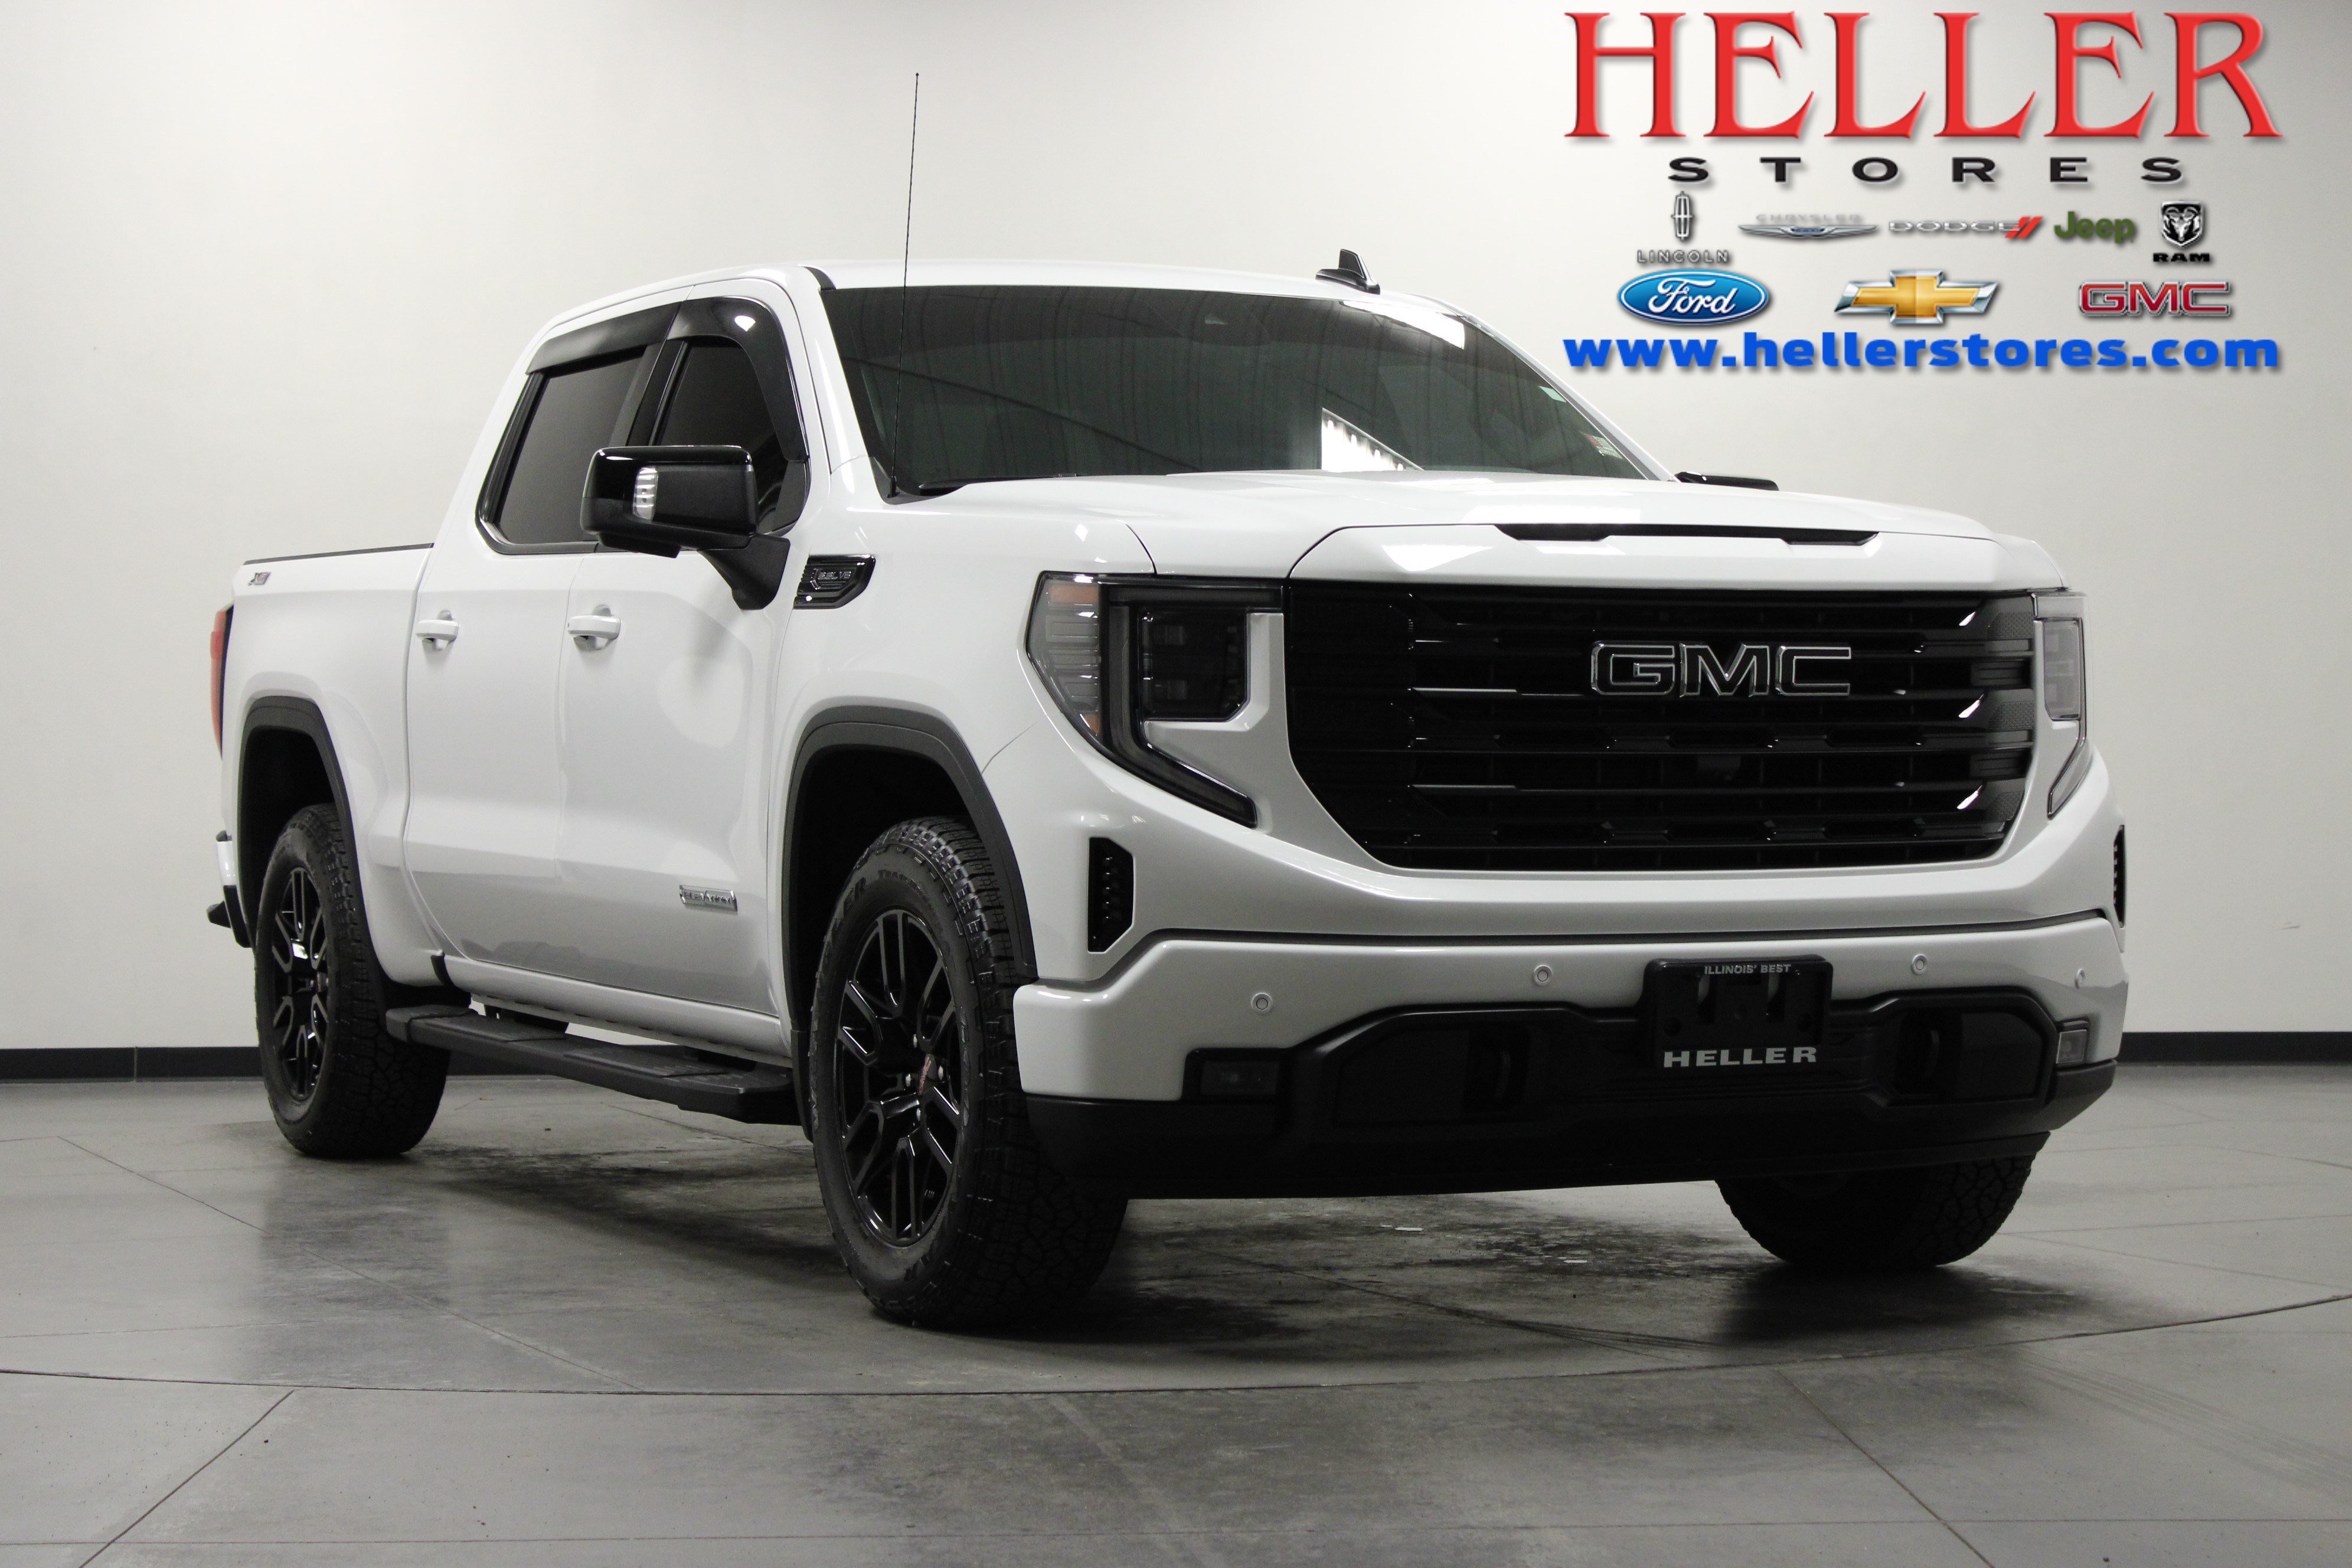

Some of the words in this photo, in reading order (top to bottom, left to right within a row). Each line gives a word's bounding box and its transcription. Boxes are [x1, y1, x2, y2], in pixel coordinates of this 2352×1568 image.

[1590, 641, 1851, 698] GMC
[1704, 965, 1757, 975] ILLINOIS'
[1760, 963, 1792, 974] BEST
[1664, 1046, 1817, 1068] HELLER
